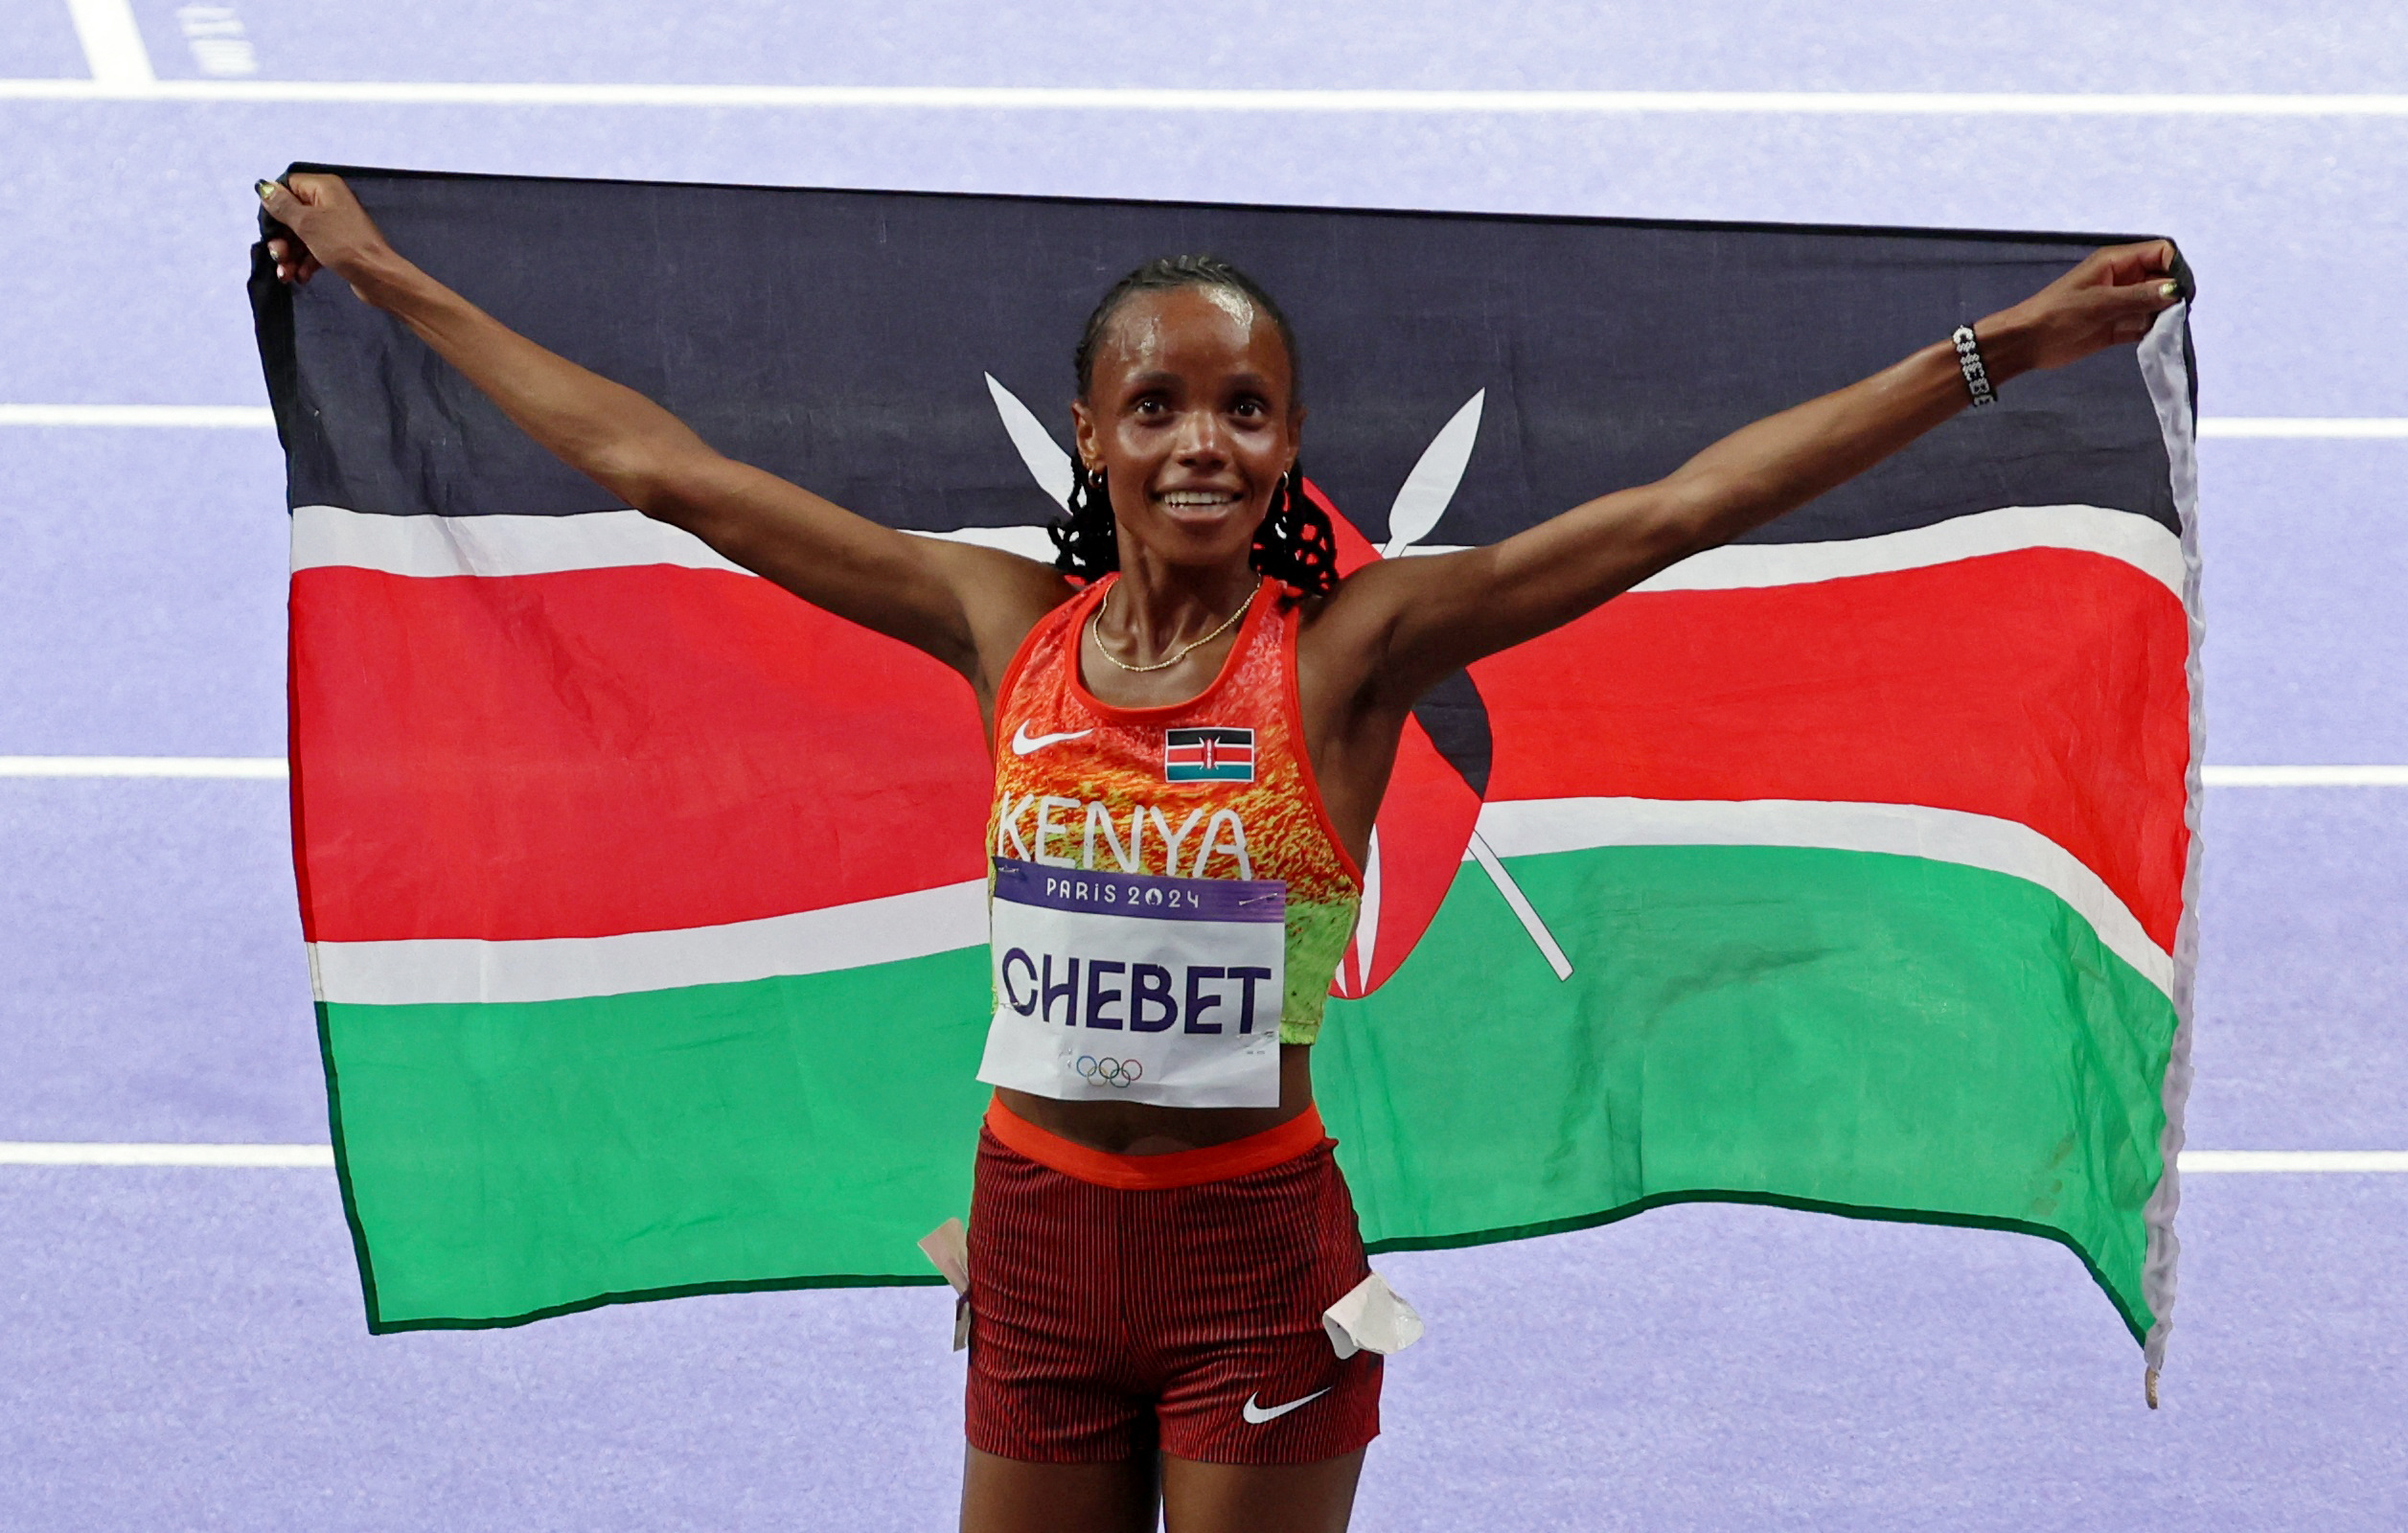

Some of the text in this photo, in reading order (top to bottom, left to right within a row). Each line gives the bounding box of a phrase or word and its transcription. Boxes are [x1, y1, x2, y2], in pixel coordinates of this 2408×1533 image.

[998, 790, 1251, 881] KENYA
[1046, 878, 1199, 908] PARIS 2024
[1001, 947, 1272, 1035] CHEBET
